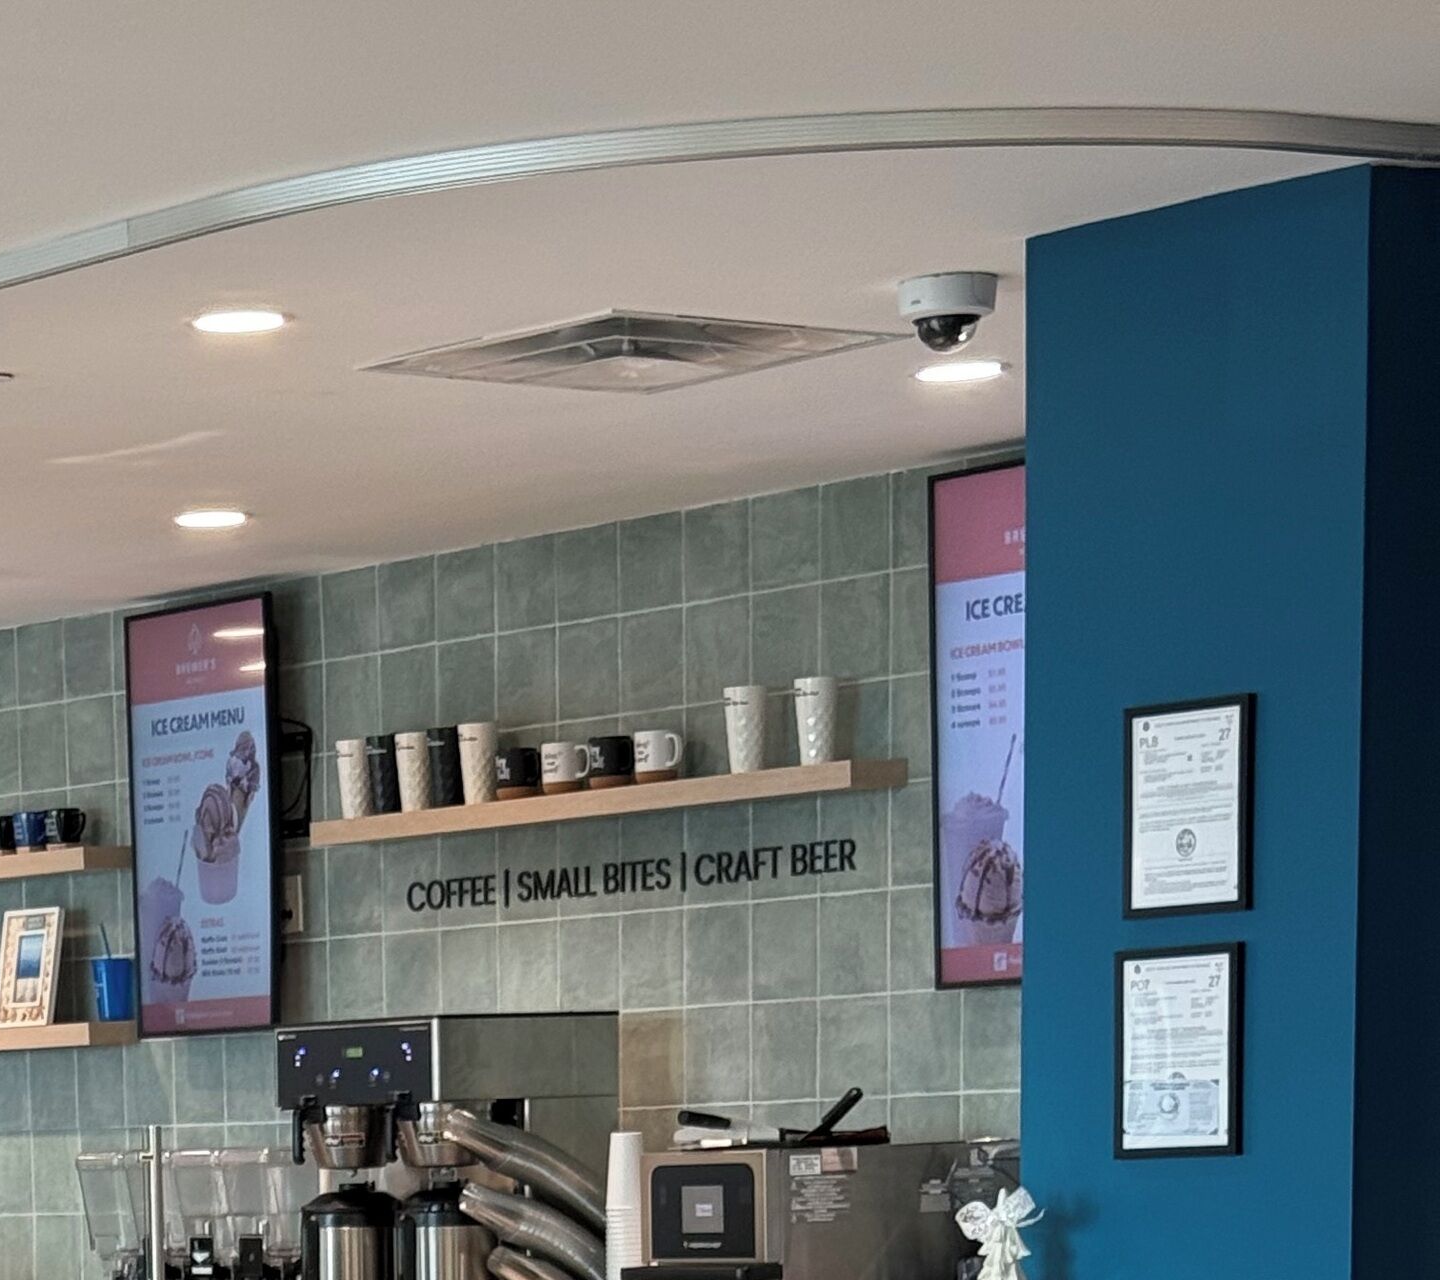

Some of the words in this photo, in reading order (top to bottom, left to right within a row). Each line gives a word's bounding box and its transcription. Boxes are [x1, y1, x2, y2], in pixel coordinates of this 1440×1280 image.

[965, 598, 990, 621] ICE
[993, 592, 1025, 616] CRE
[966, 642, 997, 658] CREAM
[151, 718, 169, 737] ICE
[170, 712, 210, 734] CREAM
[211, 706, 245, 728] MENU
[1218, 728, 1232, 742] 27
[406, 874, 497, 912] COFFEE
[517, 869, 597, 901] SMALL
[602, 858, 672, 895] BITES
[693, 846, 783, 886] CRAFT
[789, 838, 857, 877] BEER
[1208, 975, 1221, 988] 27
